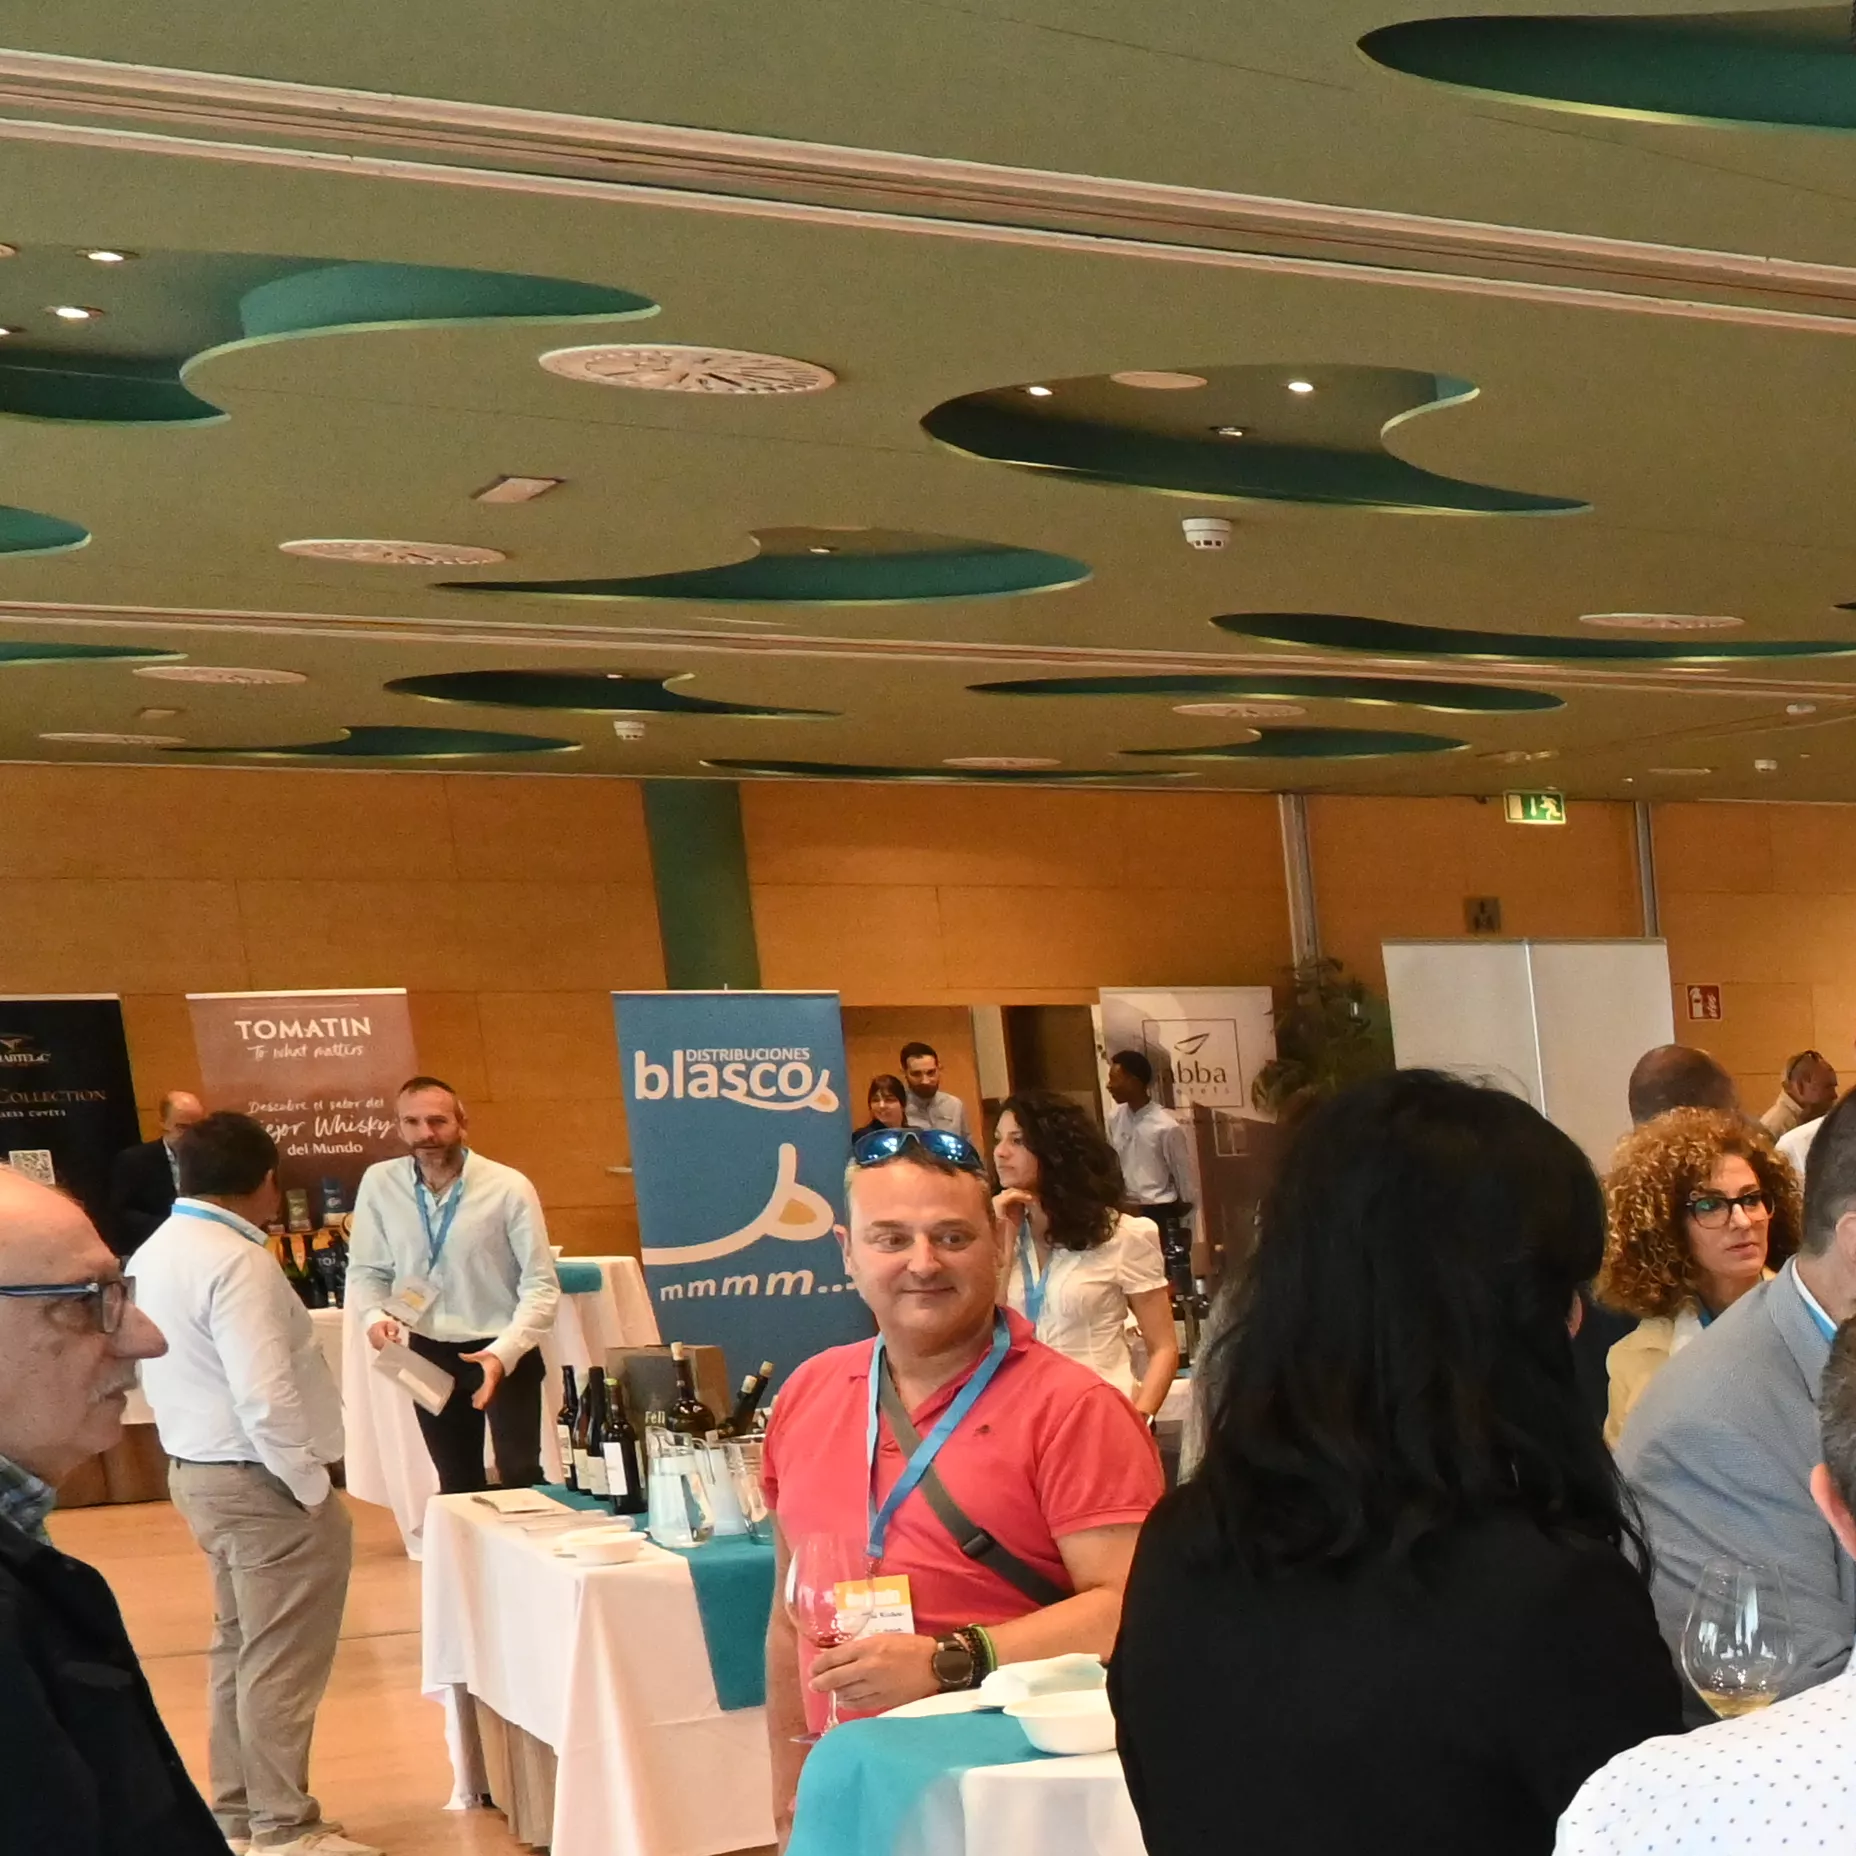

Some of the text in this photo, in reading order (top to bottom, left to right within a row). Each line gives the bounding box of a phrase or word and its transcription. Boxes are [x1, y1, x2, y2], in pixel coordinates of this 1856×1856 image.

[234, 1016, 372, 1041] TOMATIN
[247, 1043, 364, 1061] To what matters
[686, 1047, 811, 1062] DISTRIBUCIONES
[634, 1050, 814, 1100] blasco
[259, 1113, 394, 1144] ejor Whisky
[287, 1141, 364, 1156] del Mundo
